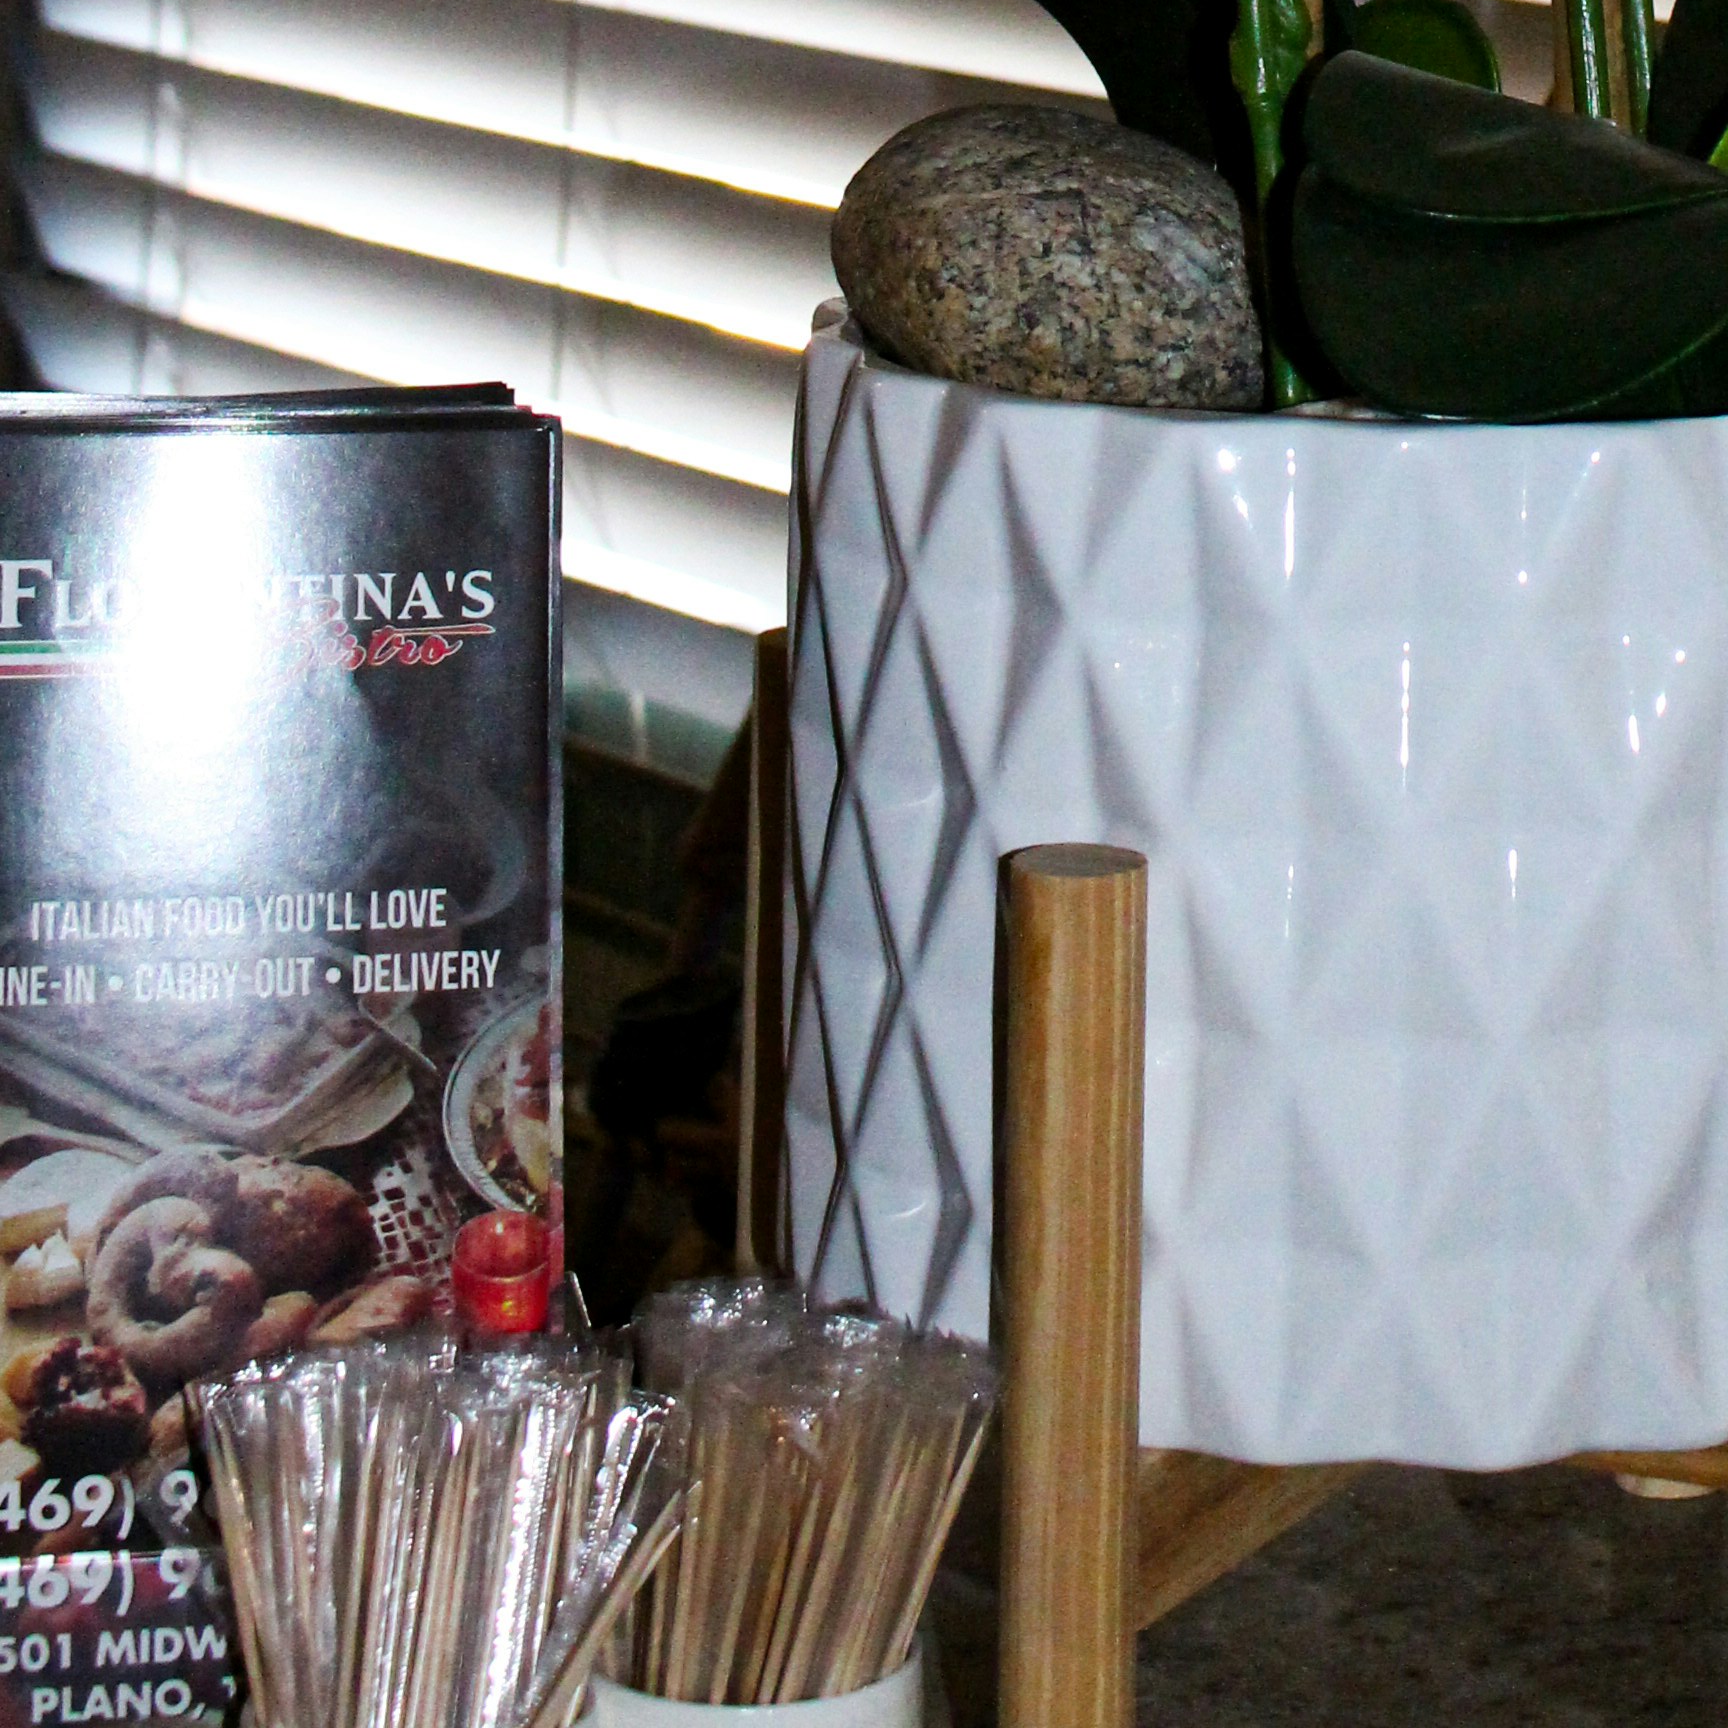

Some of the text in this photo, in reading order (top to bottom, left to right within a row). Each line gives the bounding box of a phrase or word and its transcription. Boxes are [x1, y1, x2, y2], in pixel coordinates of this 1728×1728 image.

[31, 887, 448, 941] ITALIAN FOOD YOU'LL LOVE
[0, 948, 501, 1007] INE-IN CARRY-OUT DELIVERY
[31, 1678, 206, 1724] PLANO,
